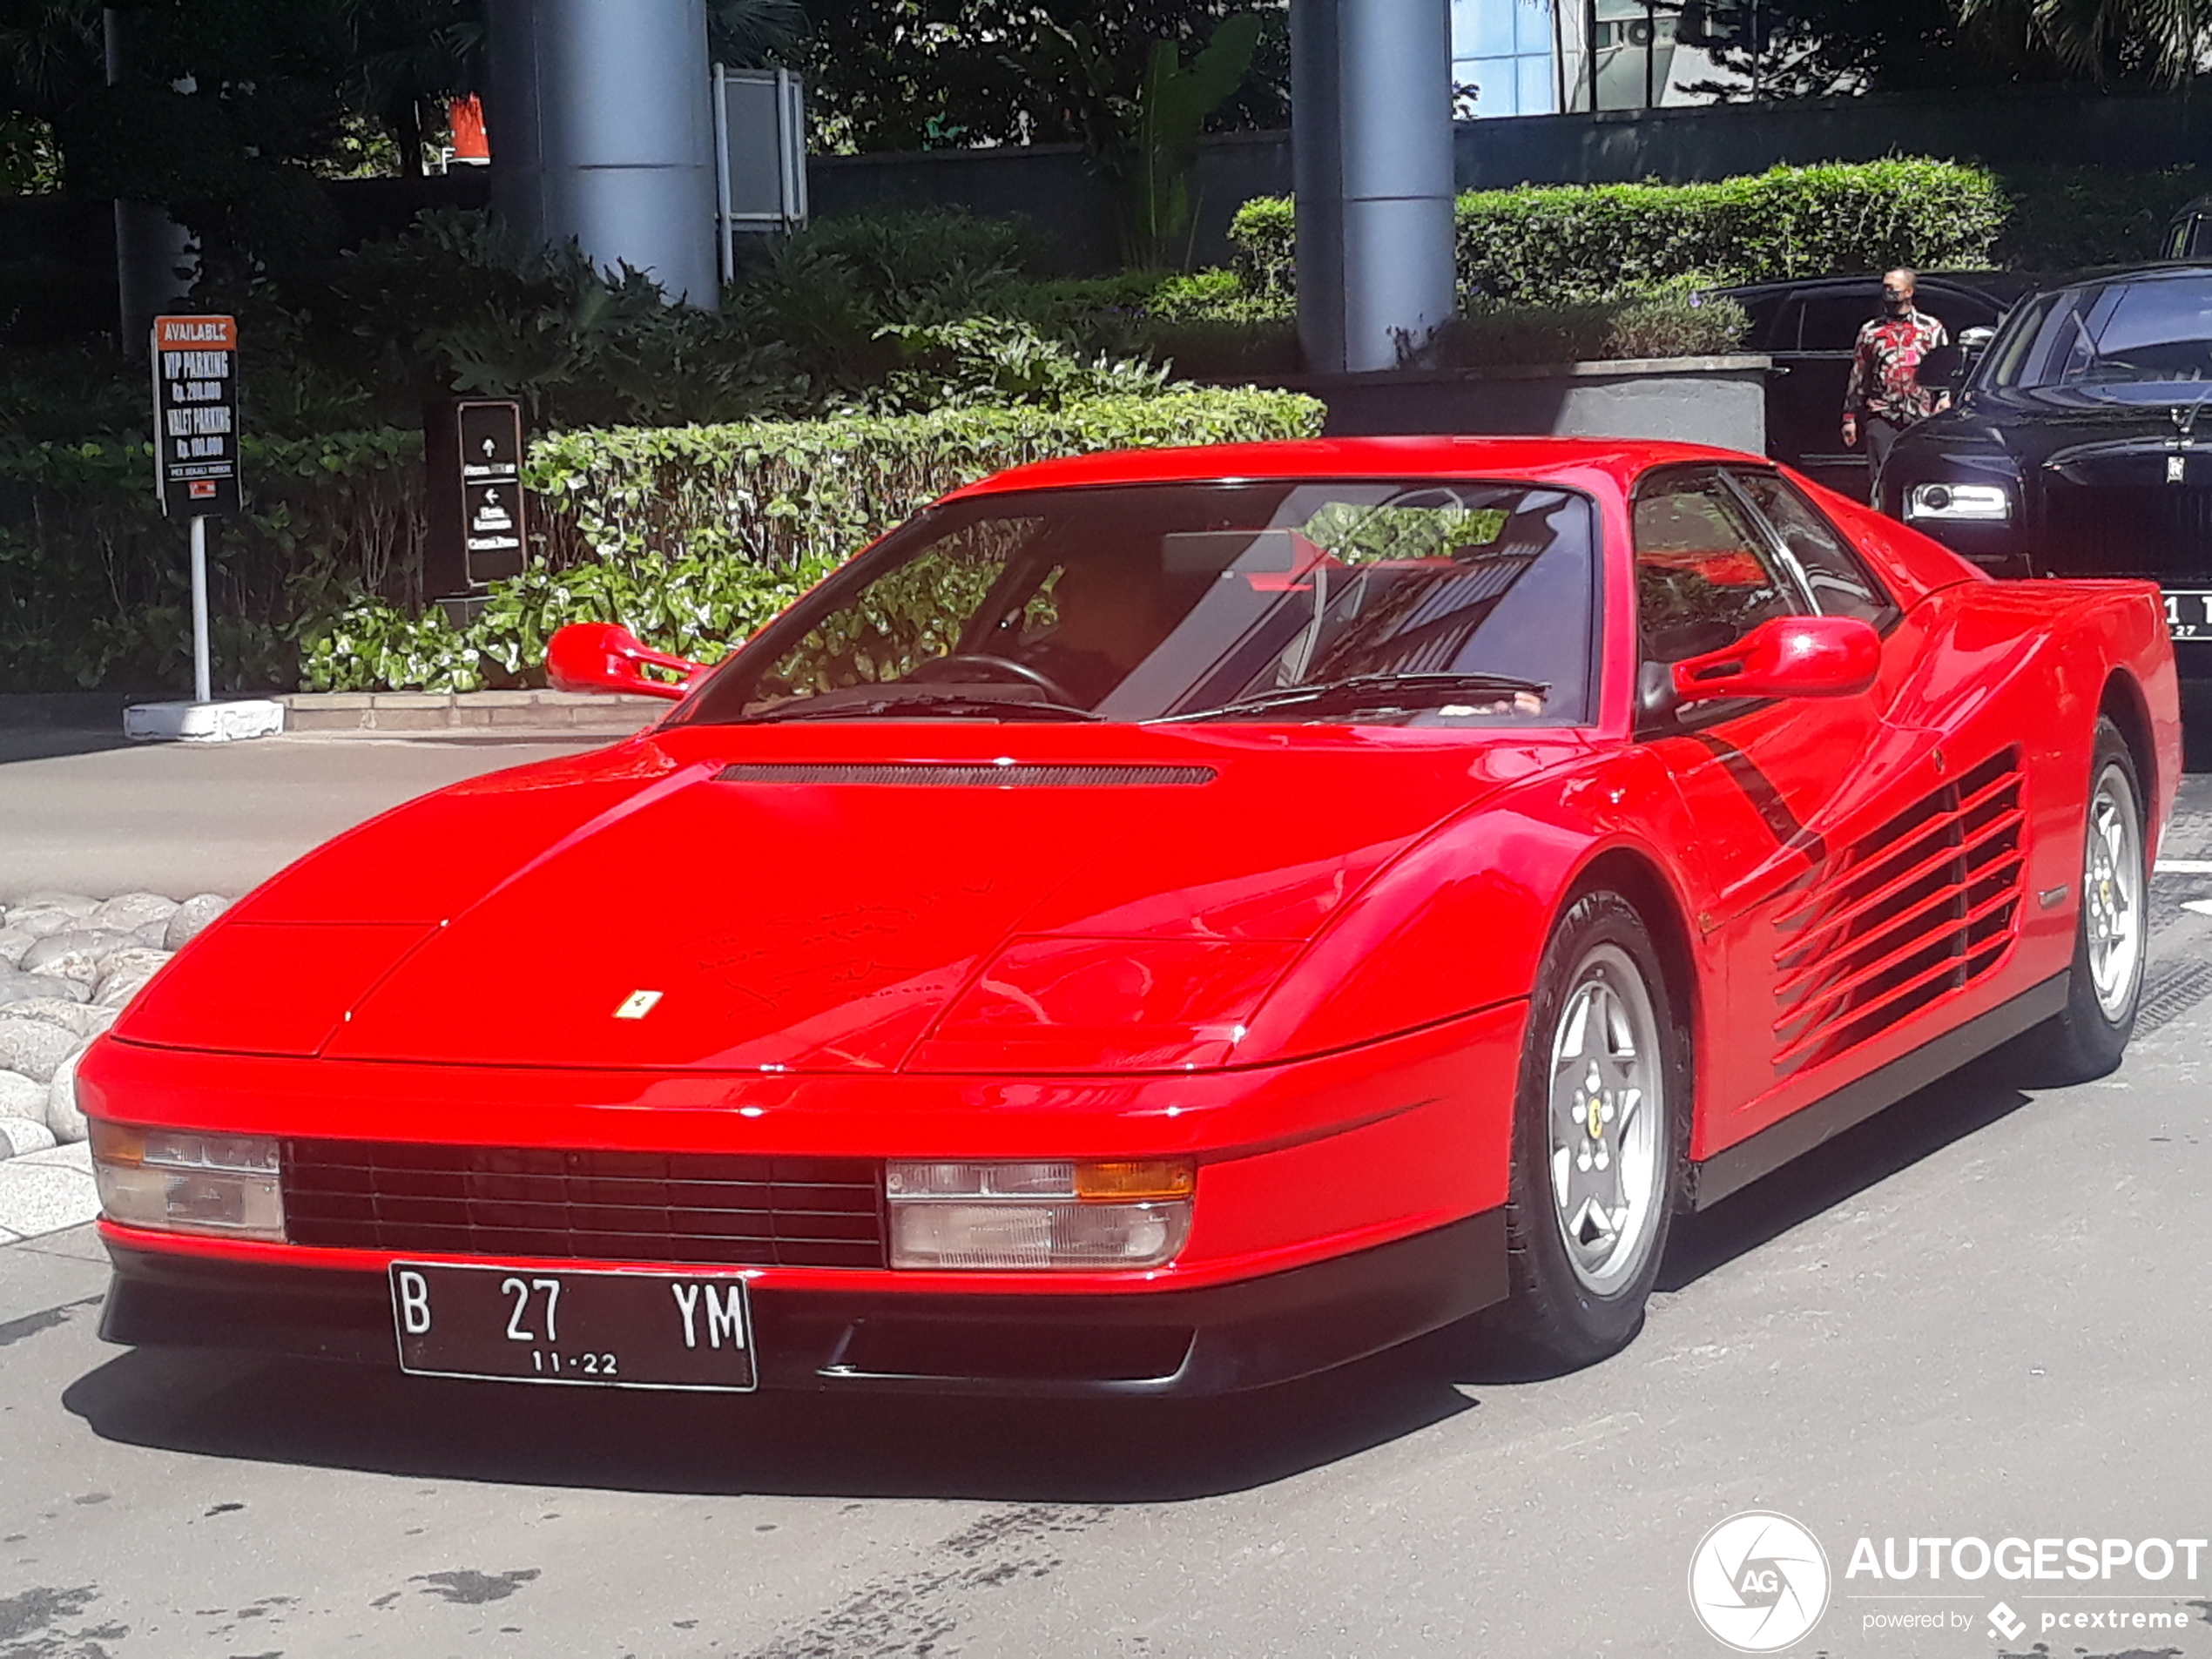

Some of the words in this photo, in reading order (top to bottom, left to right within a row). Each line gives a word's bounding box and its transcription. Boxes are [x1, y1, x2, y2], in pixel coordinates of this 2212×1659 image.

[165, 323, 227, 341] AVAILABLE
[164, 351, 182, 380] VIP
[184, 350, 228, 379] PARKING
[166, 408, 192, 435] VALET
[193, 406, 231, 434] PARKING
[400, 1271, 430, 1334] B
[502, 1278, 560, 1342] 27
[672, 1284, 745, 1349] YM
